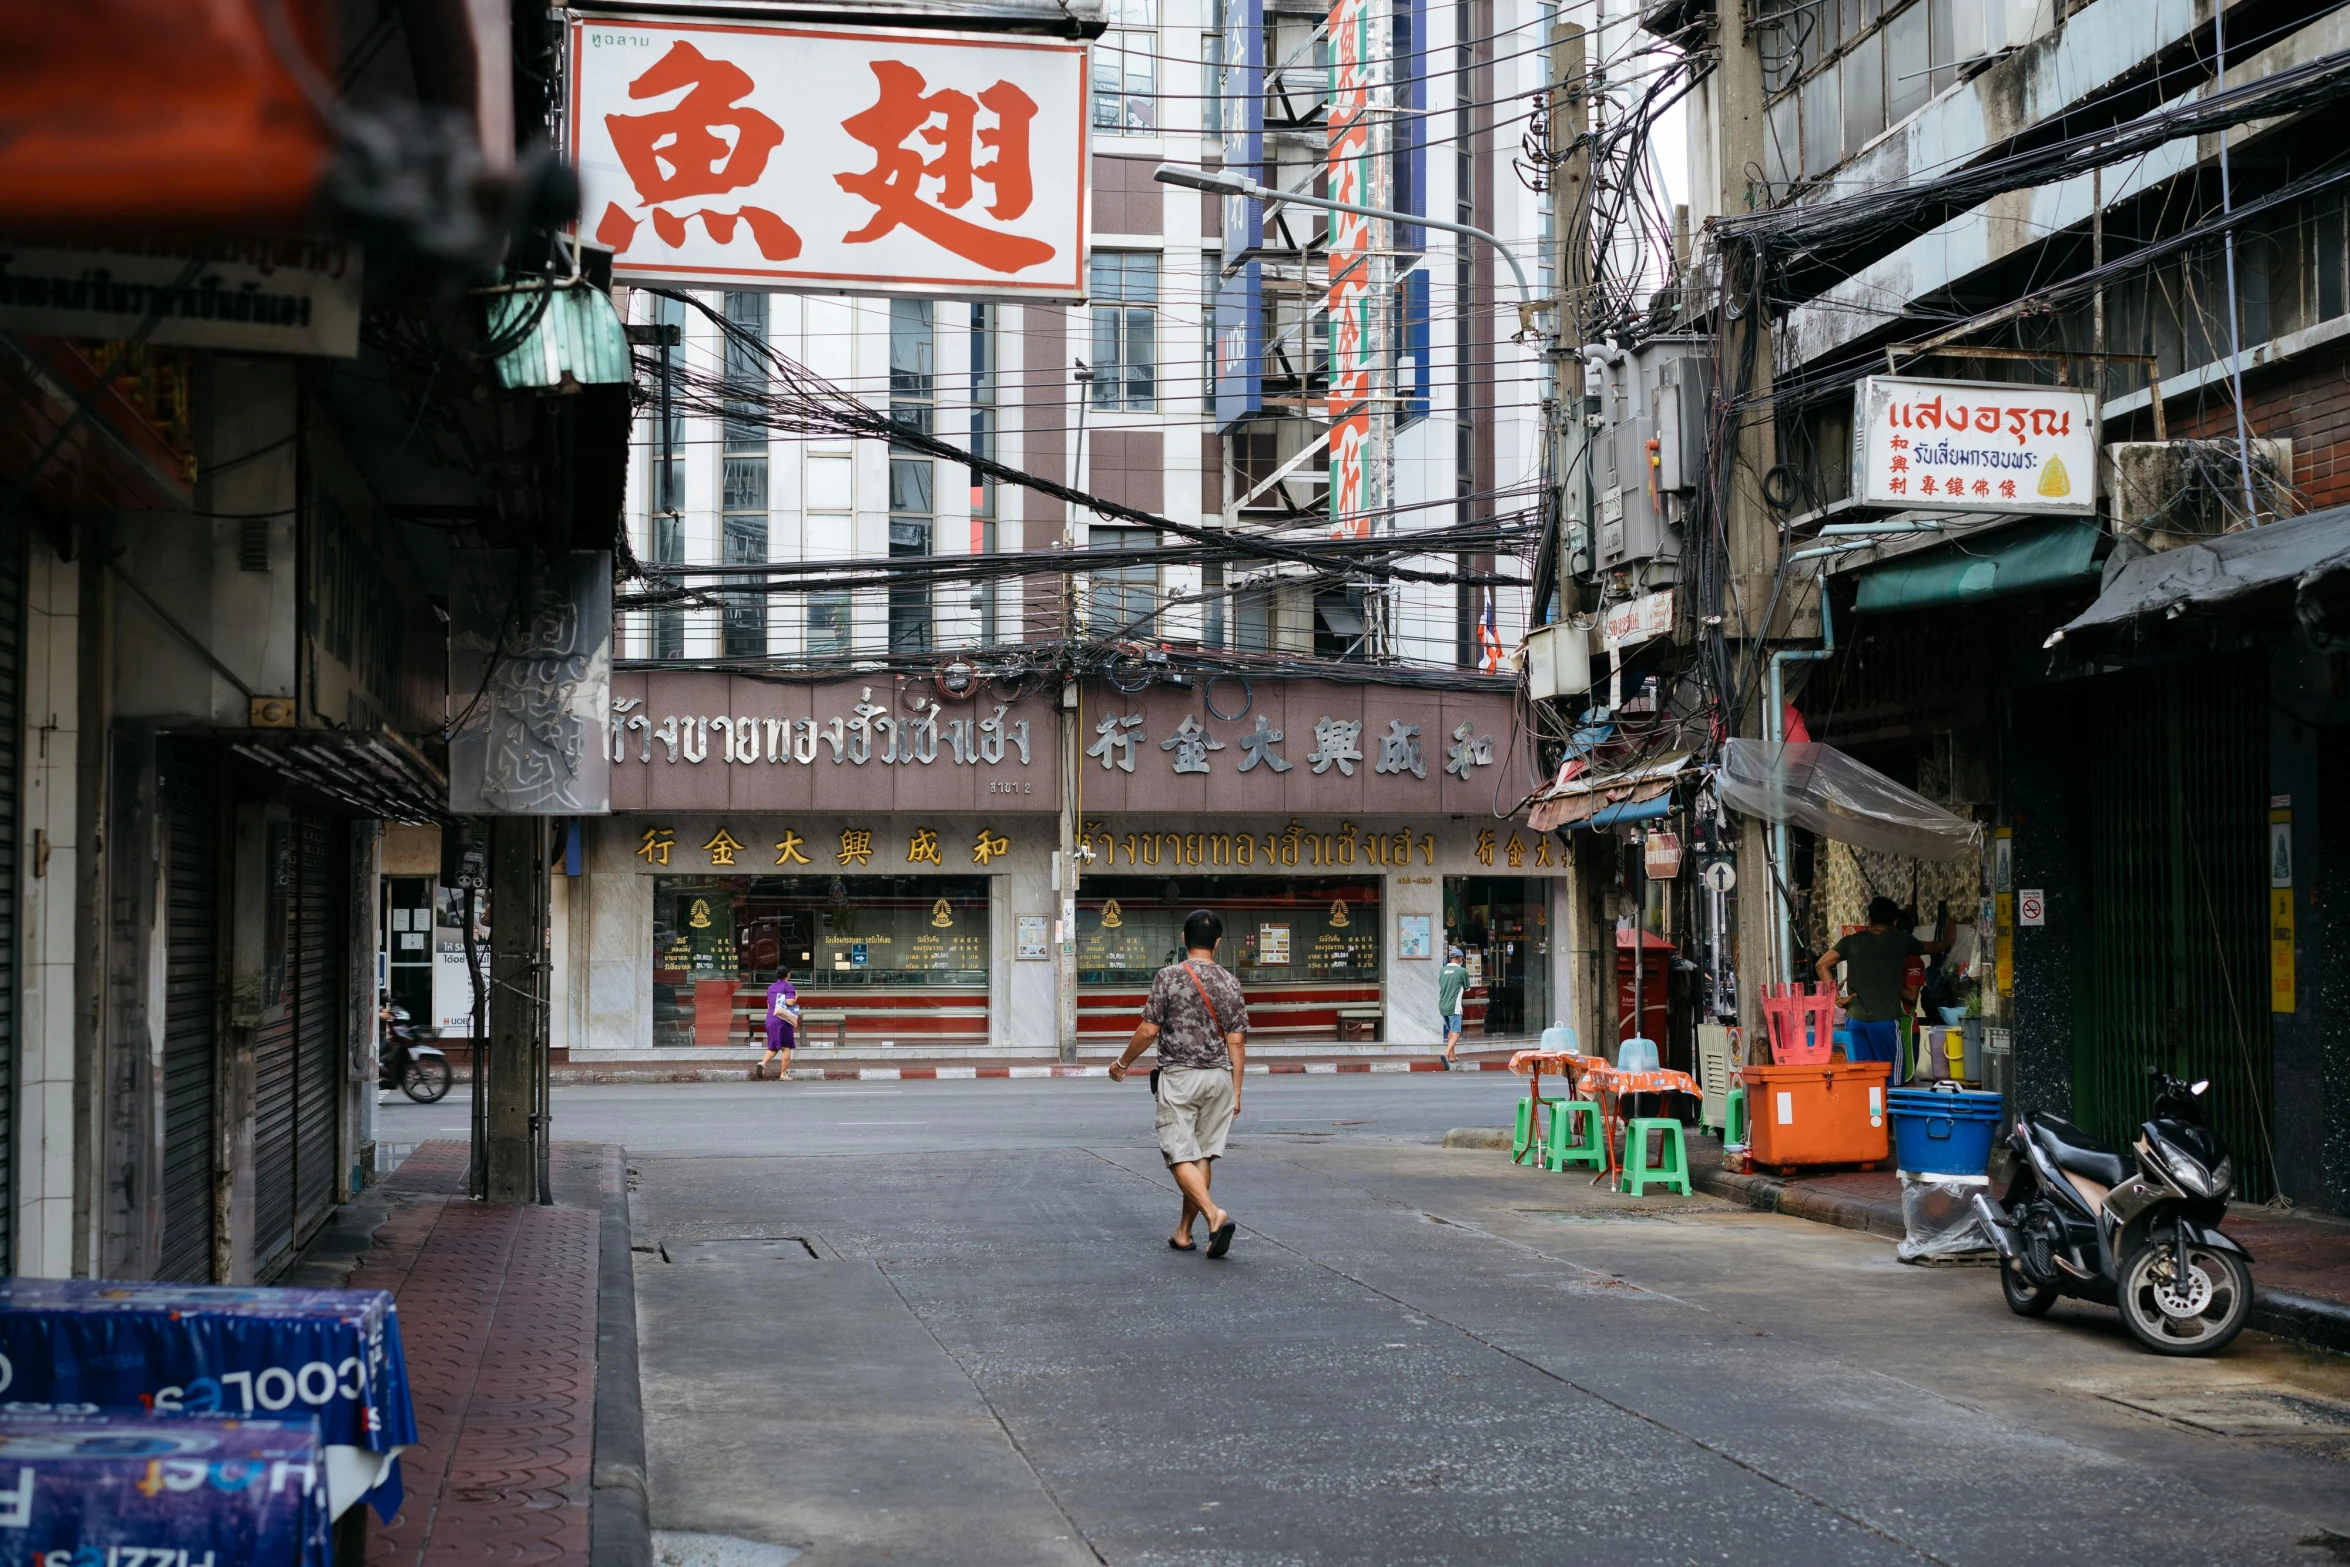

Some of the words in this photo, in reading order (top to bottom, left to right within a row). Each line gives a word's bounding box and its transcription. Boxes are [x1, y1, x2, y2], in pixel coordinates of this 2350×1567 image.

[596, 39, 1056, 274] 魚翅
[1226, 320, 1245, 372] UOB
[1889, 394, 2070, 446] แสงอรุณ
[1914, 437, 2038, 469] รับเลี่ยมกรอบพระ
[1024, 783, 1031, 794] 2
